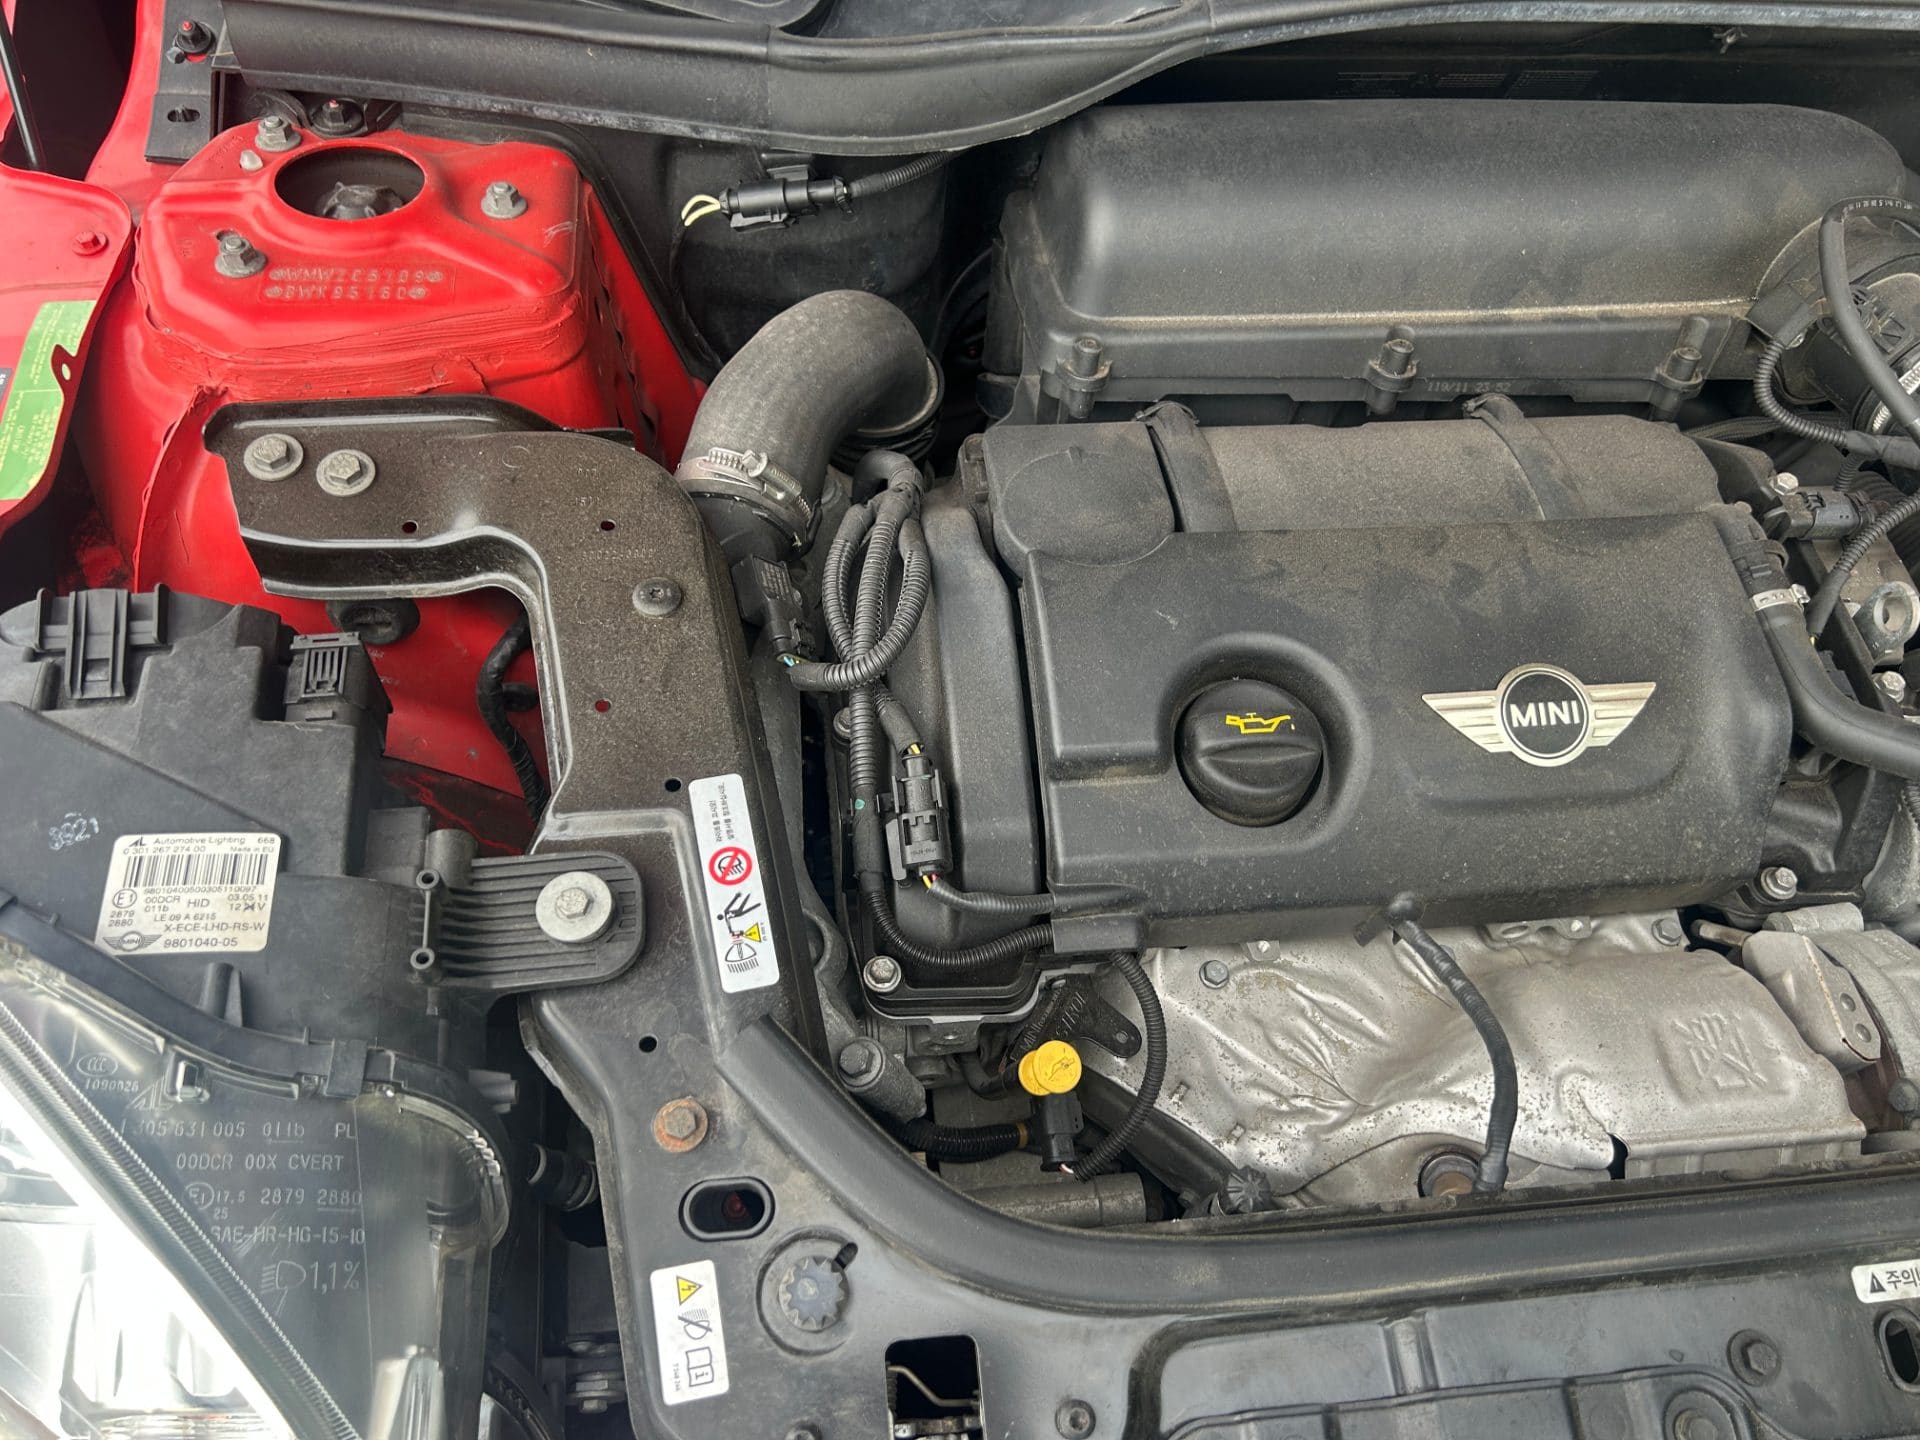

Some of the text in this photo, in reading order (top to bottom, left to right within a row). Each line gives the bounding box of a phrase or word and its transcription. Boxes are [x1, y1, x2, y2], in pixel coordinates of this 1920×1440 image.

[1509, 700, 1581, 728] MINI
[153, 837, 206, 845] Automotive
[208, 837, 245, 845] Lighting
[187, 898, 210, 908] HID
[164, 937, 238, 948] 9801040-05
[213, 1120, 246, 1137] 005
[334, 1123, 357, 1139] PL
[288, 1155, 344, 1172] CVERT
[260, 1188, 305, 1205] 2879
